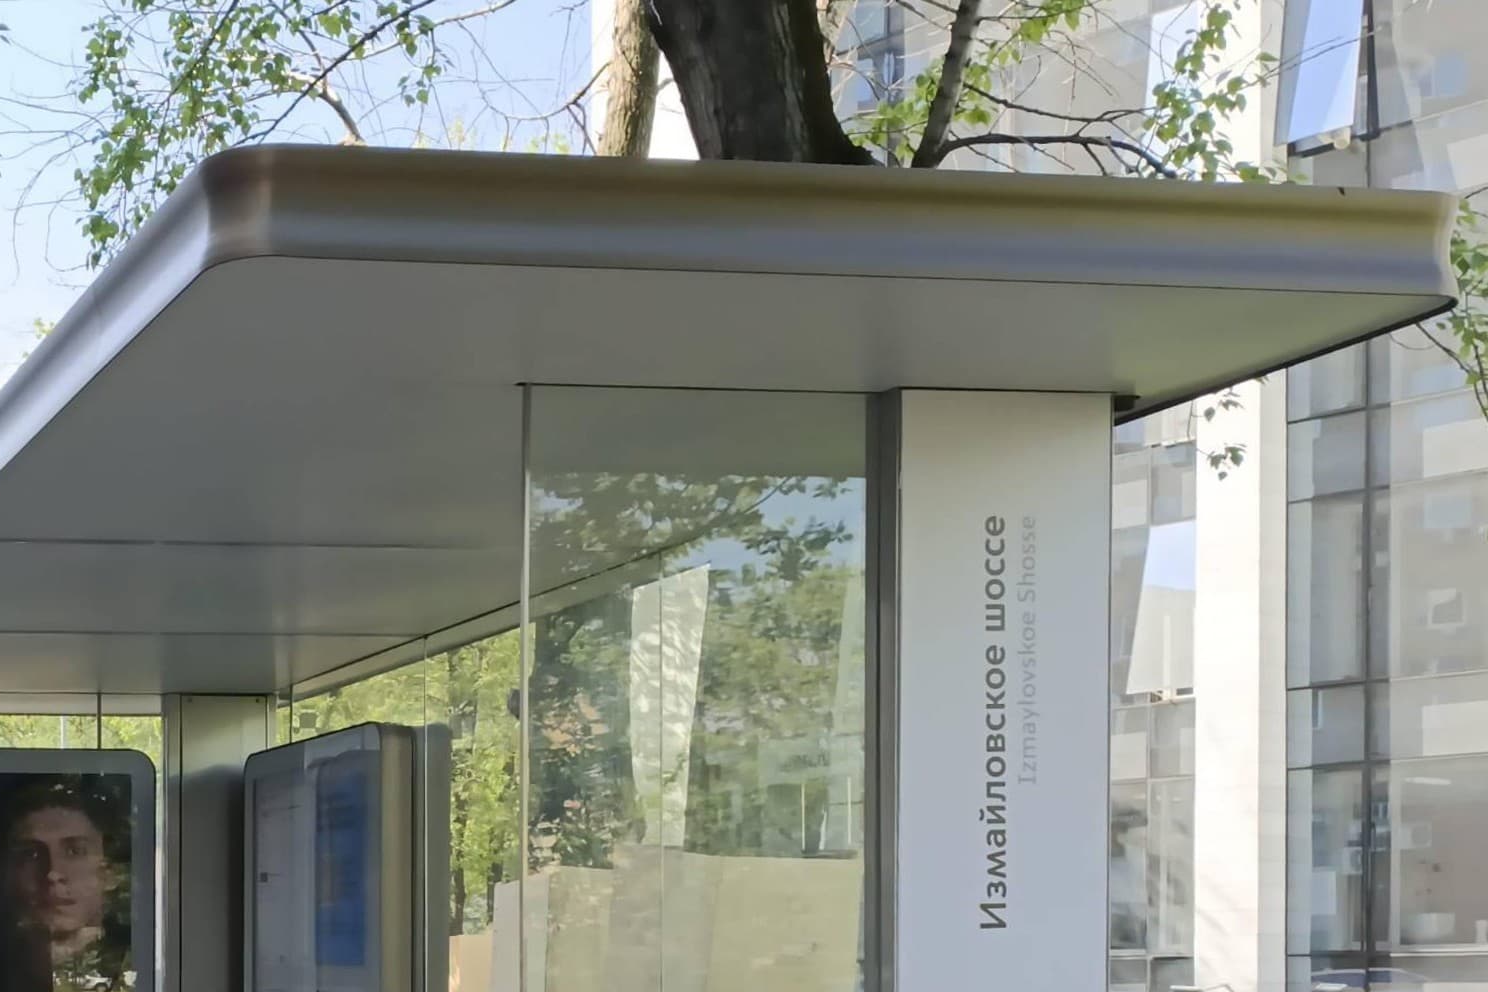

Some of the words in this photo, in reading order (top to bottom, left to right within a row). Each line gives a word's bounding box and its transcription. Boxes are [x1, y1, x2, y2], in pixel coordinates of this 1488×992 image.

[984, 515, 1007, 632] шоссе
[1017, 515, 1037, 603] Shosse
[1017, 611, 1039, 785] Izmaylovskoe
[979, 645, 1007, 930] Измайловское
